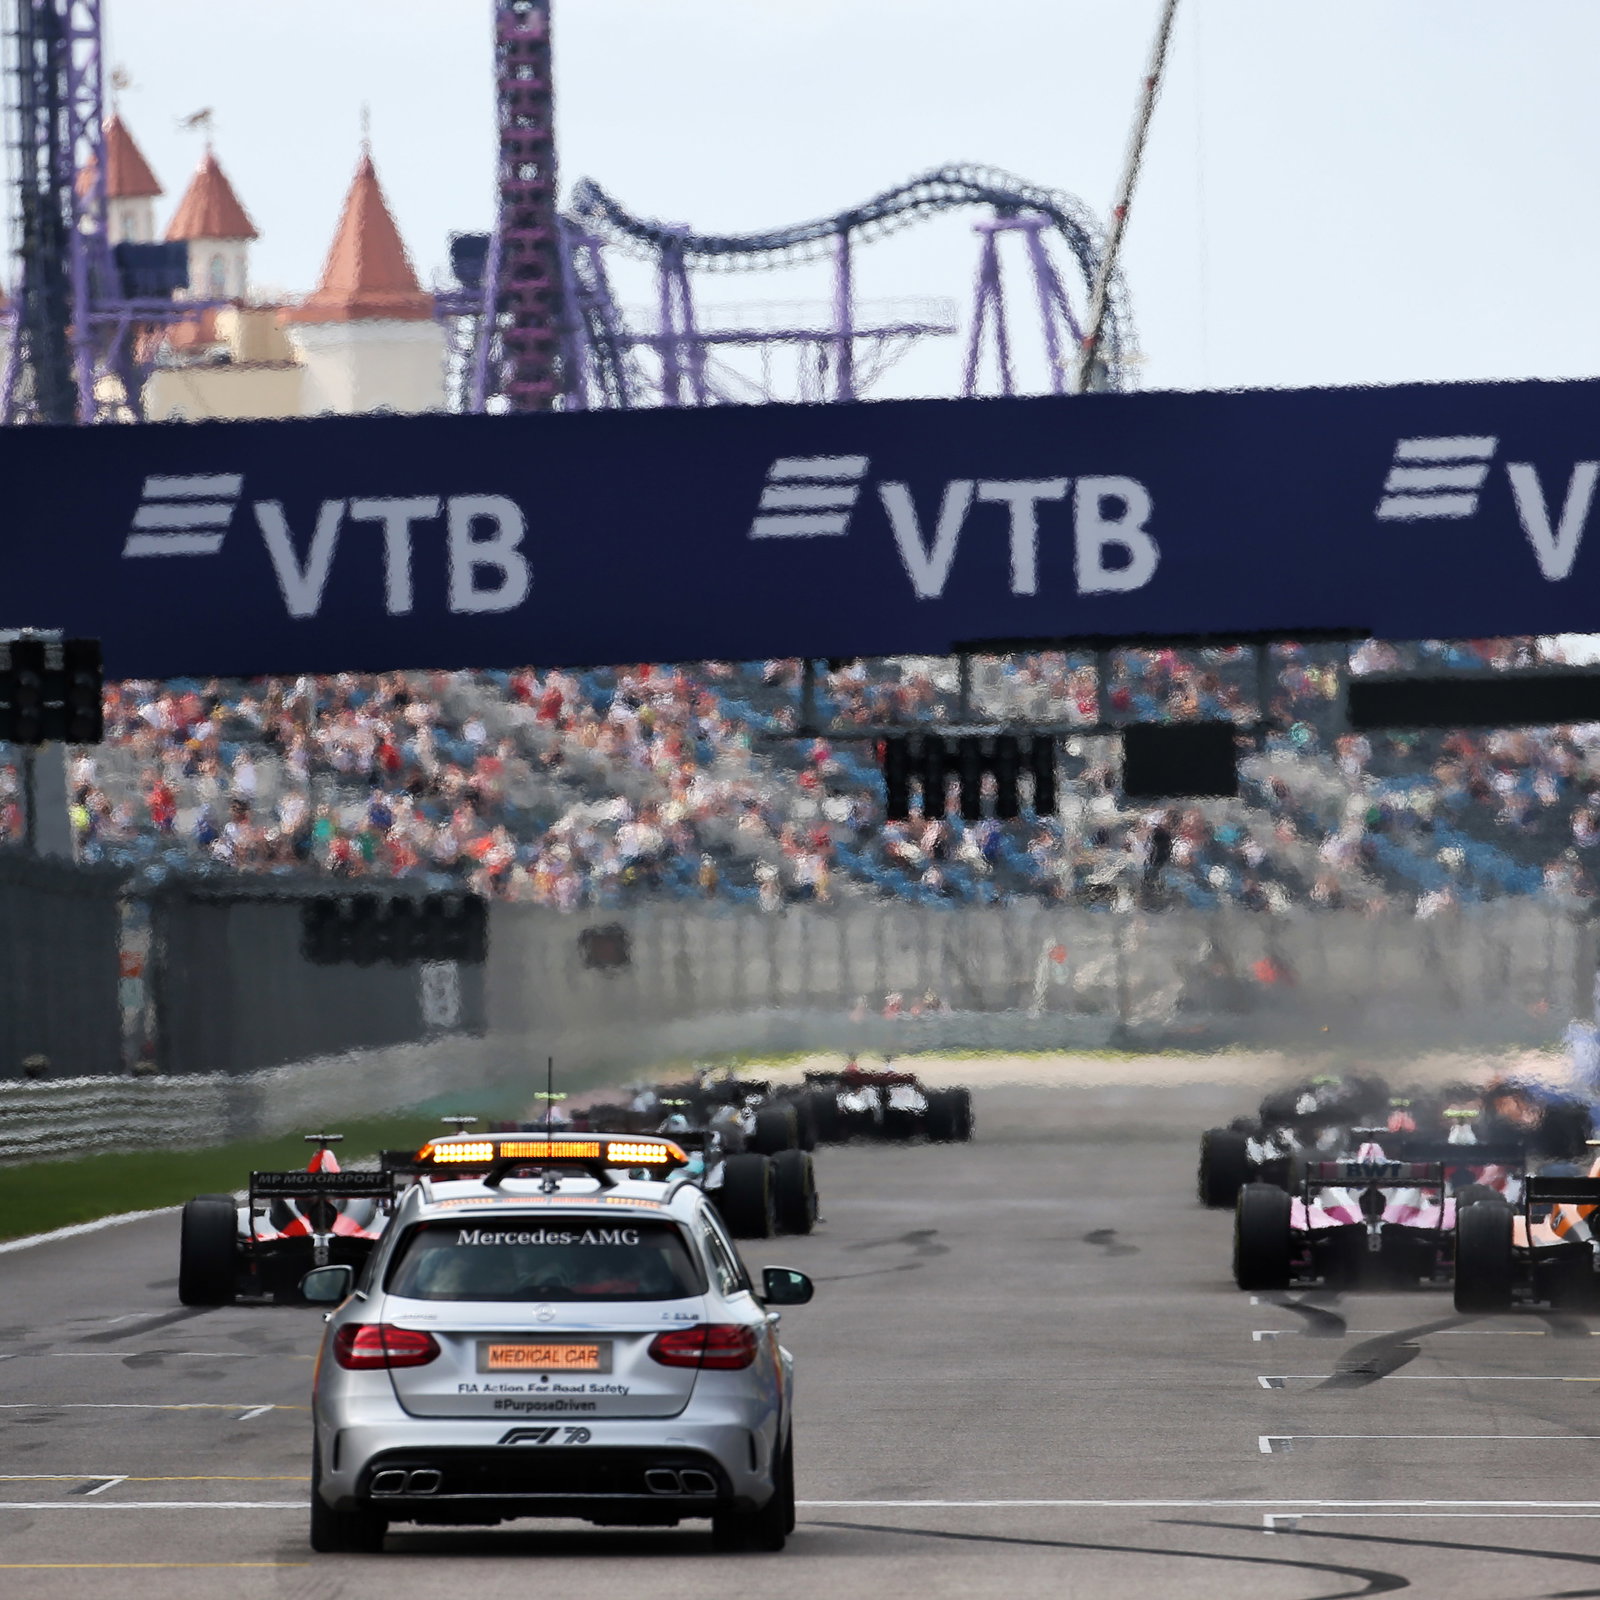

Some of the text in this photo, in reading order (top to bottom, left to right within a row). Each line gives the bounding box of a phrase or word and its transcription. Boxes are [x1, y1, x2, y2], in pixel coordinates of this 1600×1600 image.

[877, 474, 1160, 600] VTB
[253, 494, 533, 618] VTB
[1346, 1163, 1401, 1177] BWT
[258, 1173, 384, 1185] MP MOTORSPORT
[456, 1228, 640, 1246] Mercedes-AMG
[490, 1349, 600, 1363] MEDICAL CAR
[458, 1383, 630, 1396] FIA Action For Road Safety
[494, 1399, 596, 1413] #PurposeDriven
